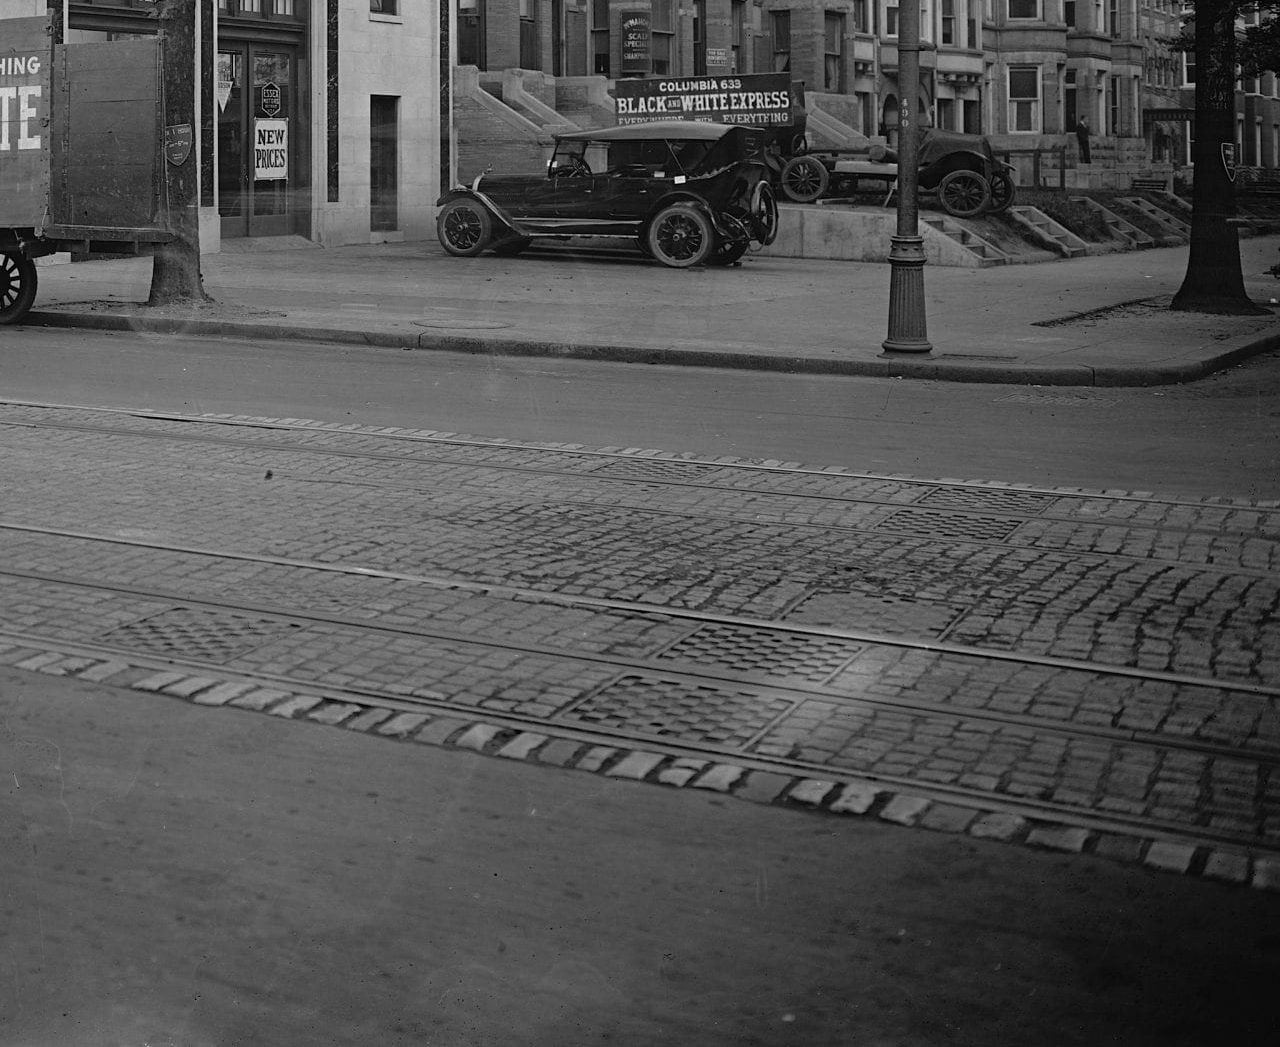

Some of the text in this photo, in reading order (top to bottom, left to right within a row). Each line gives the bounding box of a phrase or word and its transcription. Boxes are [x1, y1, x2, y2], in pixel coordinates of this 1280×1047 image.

[659, 79, 742, 92] COLUMBIA 633
[617, 91, 790, 114] BLACK AND WHITE EXPRESS
[723, 113, 788, 124] EVERYTHING
[257, 128, 285, 145] NEW
[255, 148, 286, 169] PRICES
